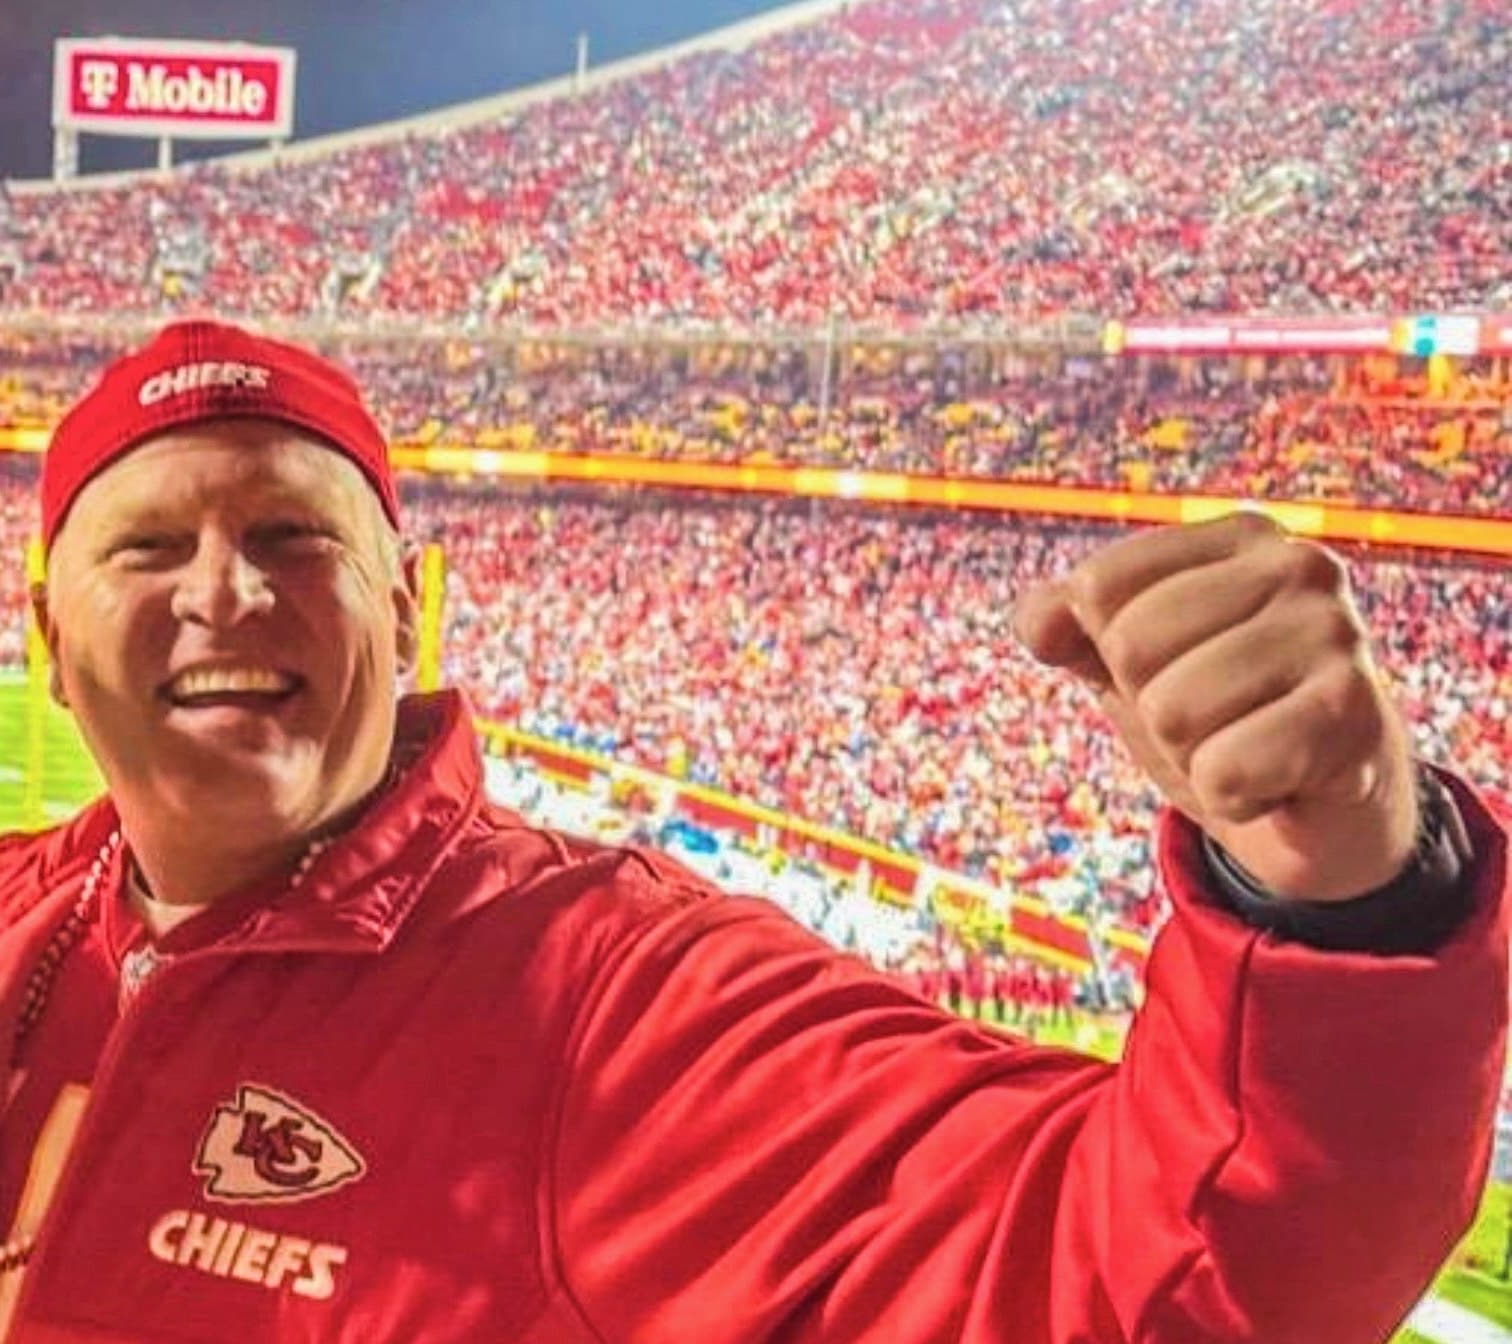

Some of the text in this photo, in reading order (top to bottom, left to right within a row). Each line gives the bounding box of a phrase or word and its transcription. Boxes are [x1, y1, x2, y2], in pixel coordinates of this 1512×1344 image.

[125, 63, 268, 116] Mobile
[138, 360, 272, 407] CHIEFS
[233, 1110, 323, 1188] KC
[147, 1209, 348, 1301] CHIEFS
